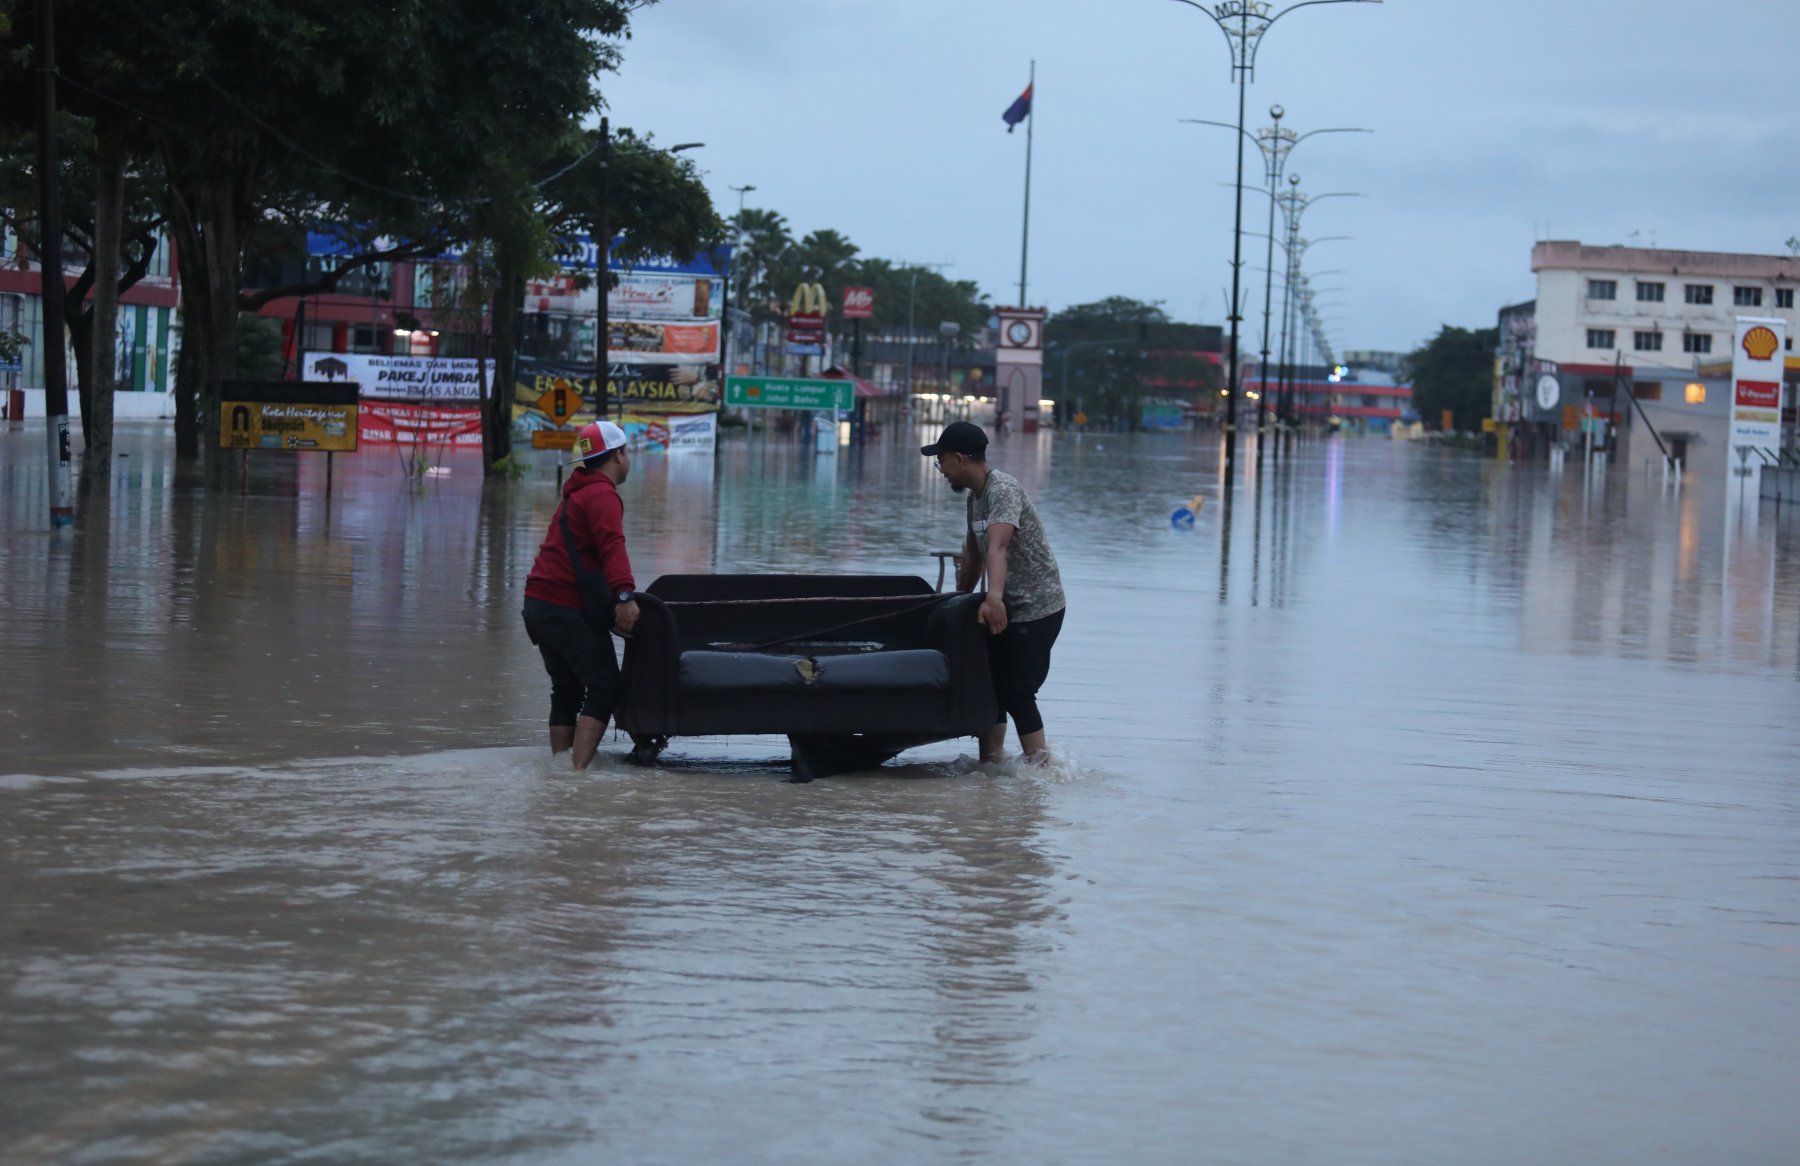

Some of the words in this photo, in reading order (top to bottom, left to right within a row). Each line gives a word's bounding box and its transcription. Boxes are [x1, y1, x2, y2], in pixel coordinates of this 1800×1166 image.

[378, 370, 427, 383] PAKEJ
[444, 386, 479, 397] ANUA
[534, 375, 584, 394] EMS
[589, 379, 677, 398] MAAYSIA
[262, 405, 285, 417] Kota
